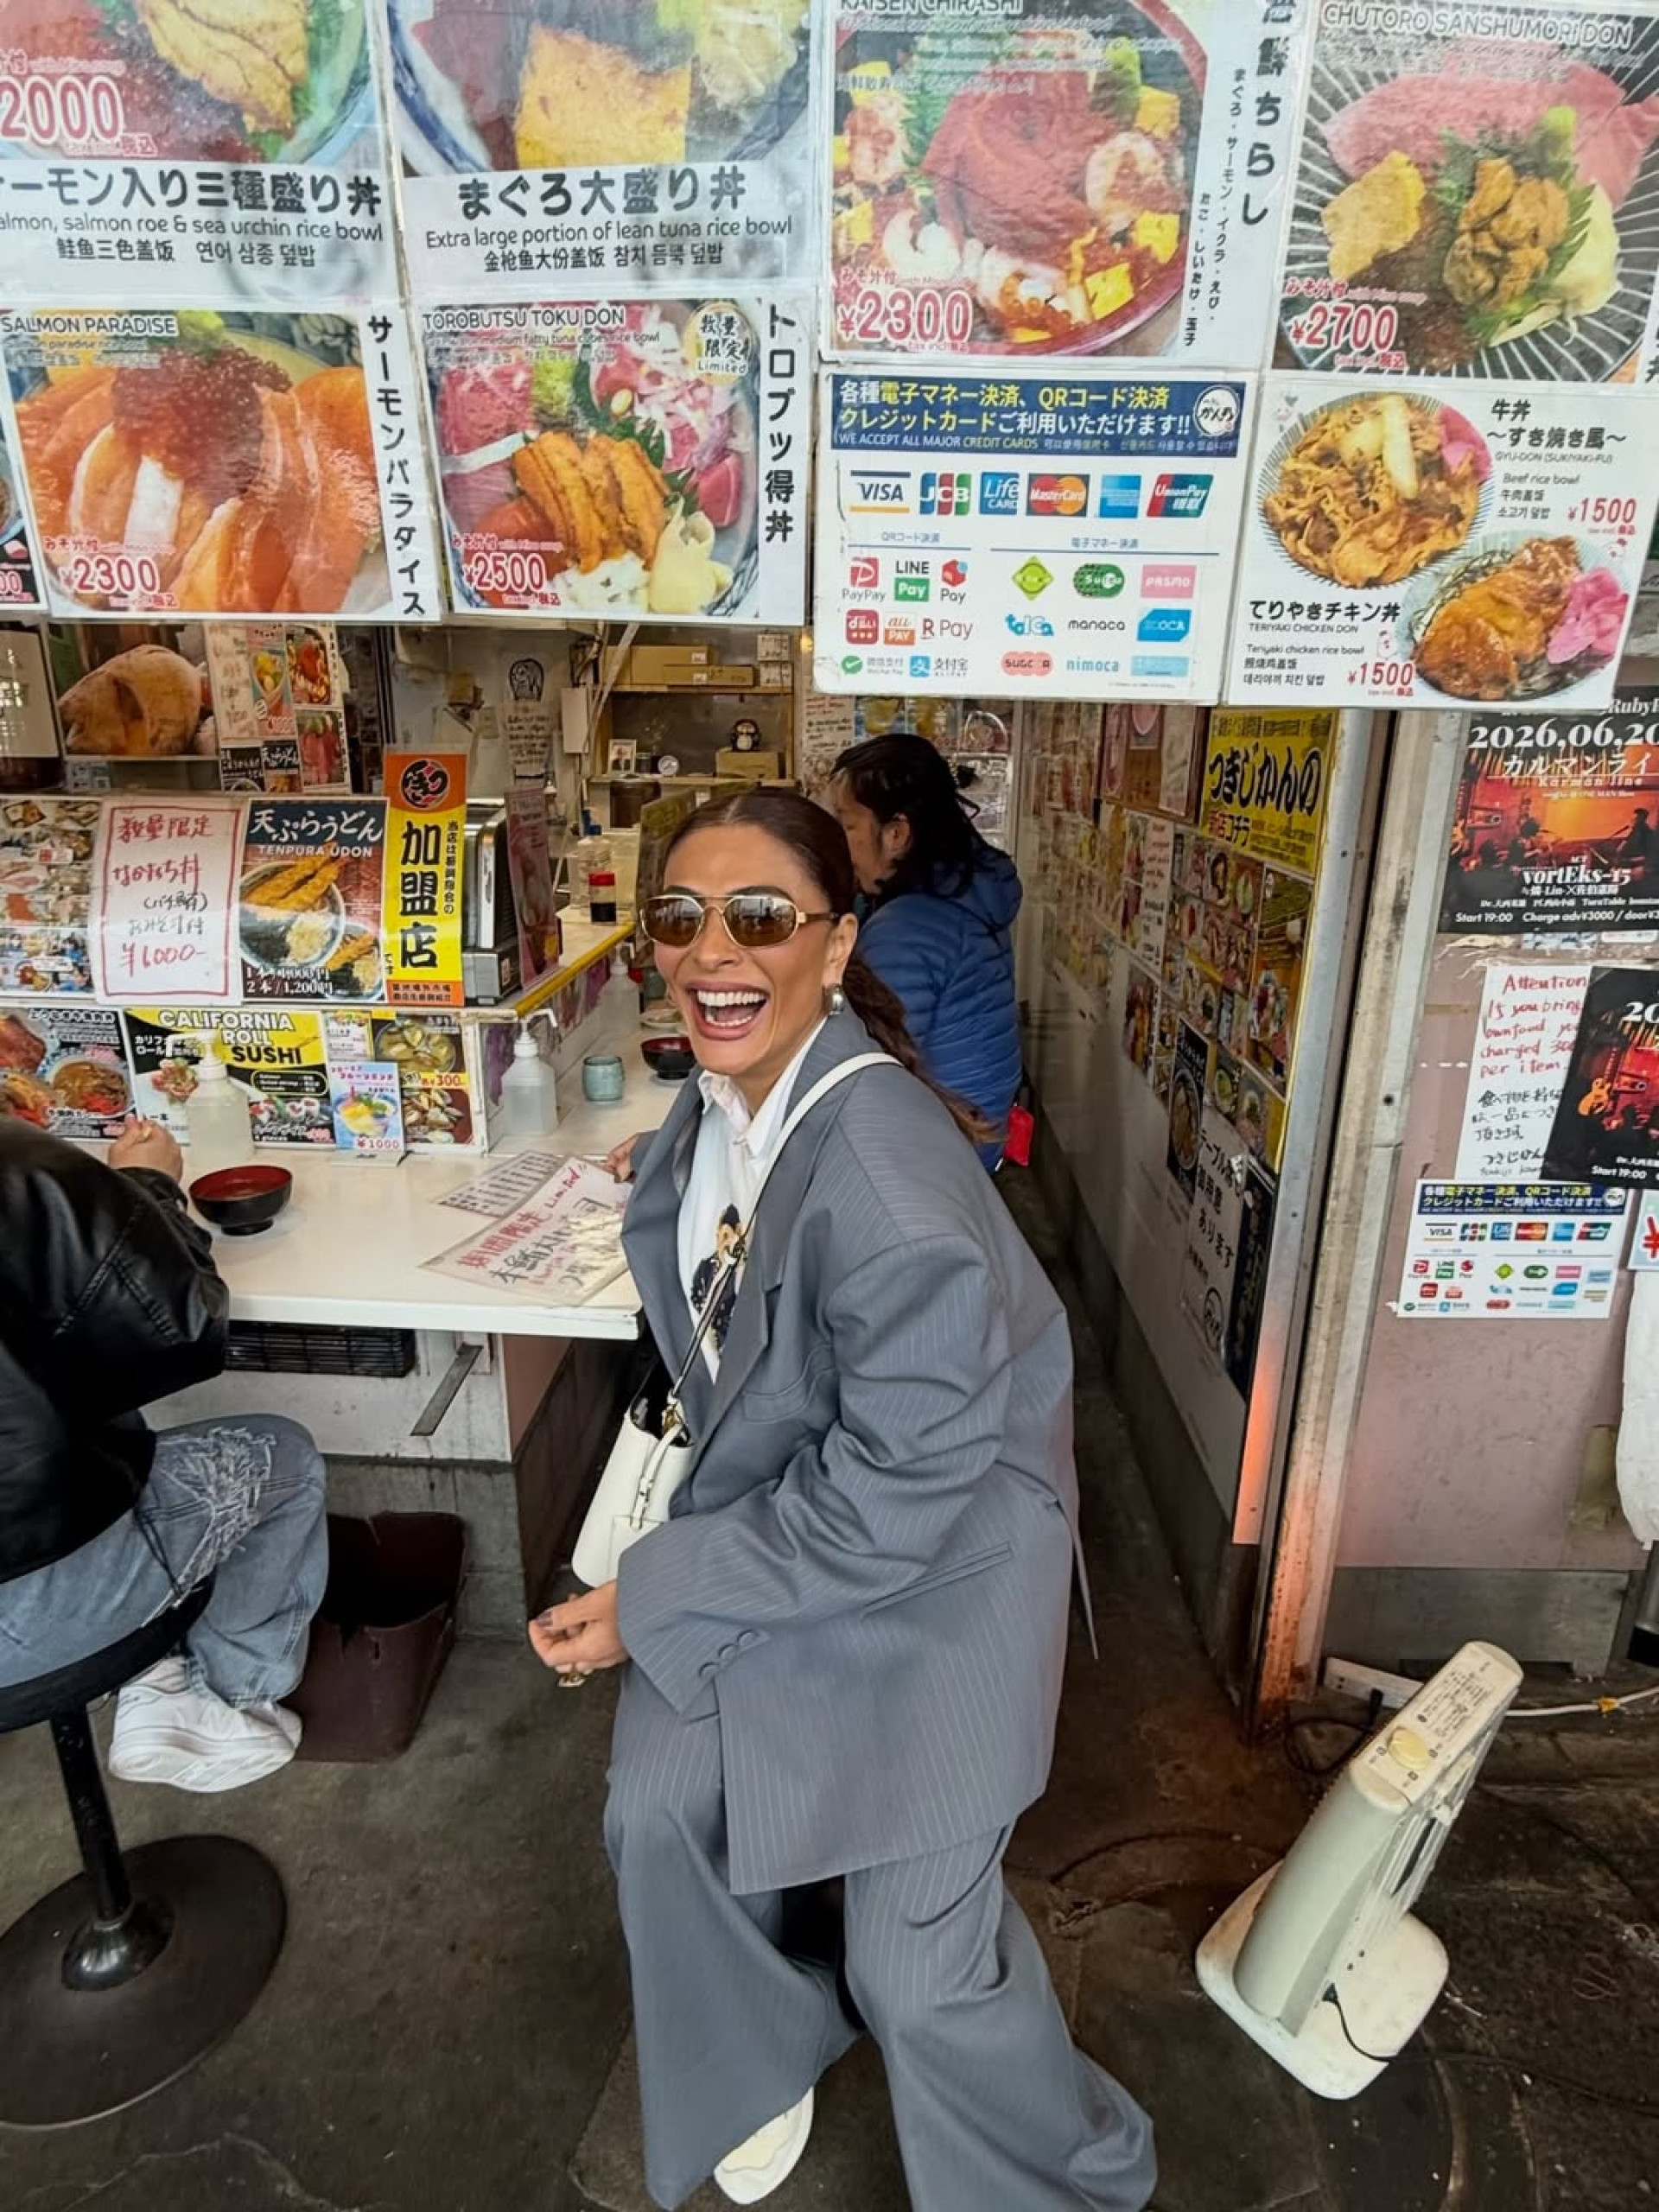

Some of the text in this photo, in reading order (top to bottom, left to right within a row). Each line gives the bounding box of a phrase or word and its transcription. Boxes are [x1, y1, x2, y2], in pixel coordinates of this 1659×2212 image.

[1323, 5, 1632, 47] CHUTORO SANSHUMORI DON
[0, 167, 382, 217] ーモン入り三種盛り丼
[458, 163, 747, 220] まぐろ大盛り丼
[63, 213, 131, 232] salmon
[137, 218, 168, 232] roe
[173, 214, 188, 232] &
[193, 219, 226, 234] sea
[232, 217, 291, 236] urchin
[296, 219, 331, 238] rice
[335, 220, 384, 241] bowl
[426, 214, 792, 250] Extra large portion of lean tuna rice bowl
[196, 240, 232, 263] 연어
[238, 241, 275, 265] 삼종
[613, 244, 646, 268] 참치
[1, 317, 177, 334] SALMON PARADISE
[423, 308, 625, 329] TOROBUTSU TOKU DON
[839, 290, 970, 340] ¥2300
[1292, 305, 1396, 351] ¥2700
[697, 359, 747, 374] Limited
[1491, 398, 1532, 422] 牛丼
[839, 432, 1037, 449] WE ACCEPT ALL MAJOR CREDIT CARDS
[1495, 451, 1542, 461] GYU-DON
[858, 482, 904, 502] VISA
[918, 486, 971, 502] JCB
[984, 477, 1020, 499] Life
[1029, 489, 1086, 502] MasterCard
[1155, 483, 1208, 501] UnionPay
[1503, 474, 1580, 485] Beef rice bowl
[1568, 497, 1637, 524] ¥1500
[61, 557, 158, 592] ¥2300
[463, 555, 545, 591] ¥2500
[895, 560, 931, 599] LINE Pay
[841, 588, 886, 602] PayPay
[940, 588, 967, 605] Pay
[1249, 600, 1402, 623] てりやきチキン丼
[888, 631, 911, 640] PAY
[939, 619, 973, 640] Pay
[1068, 619, 1126, 631] manaca
[1249, 622, 1359, 633] TERIYAKI CHICKEN DON
[1247, 643, 1365, 655] Teriyaki chicken rice bowl
[1066, 656, 1120, 673] nimoca
[1348, 662, 1414, 686] ¥1500
[1208, 741, 1322, 817] つきじかんの
[250, 809, 384, 842] 天ぷらうどん
[258, 845, 372, 858] TENPURA UDON
[399, 820, 442, 969] 加盟店
[1455, 912, 1483, 923] Start
[1484, 912, 1513, 923] 19:00
[1522, 912, 1560, 925] Charge
[1502, 973, 1587, 995] Attention
[1510, 1002, 1538, 1017] you
[1541, 998, 1581, 1016] bring
[159, 1010, 296, 1032] CALIFORNIA
[221, 1030, 273, 1046] ROLL
[231, 1046, 302, 1065] SUSHI
[1480, 1064, 1510, 1078] per
[1592, 1165, 1648, 1179] Start 19:00
